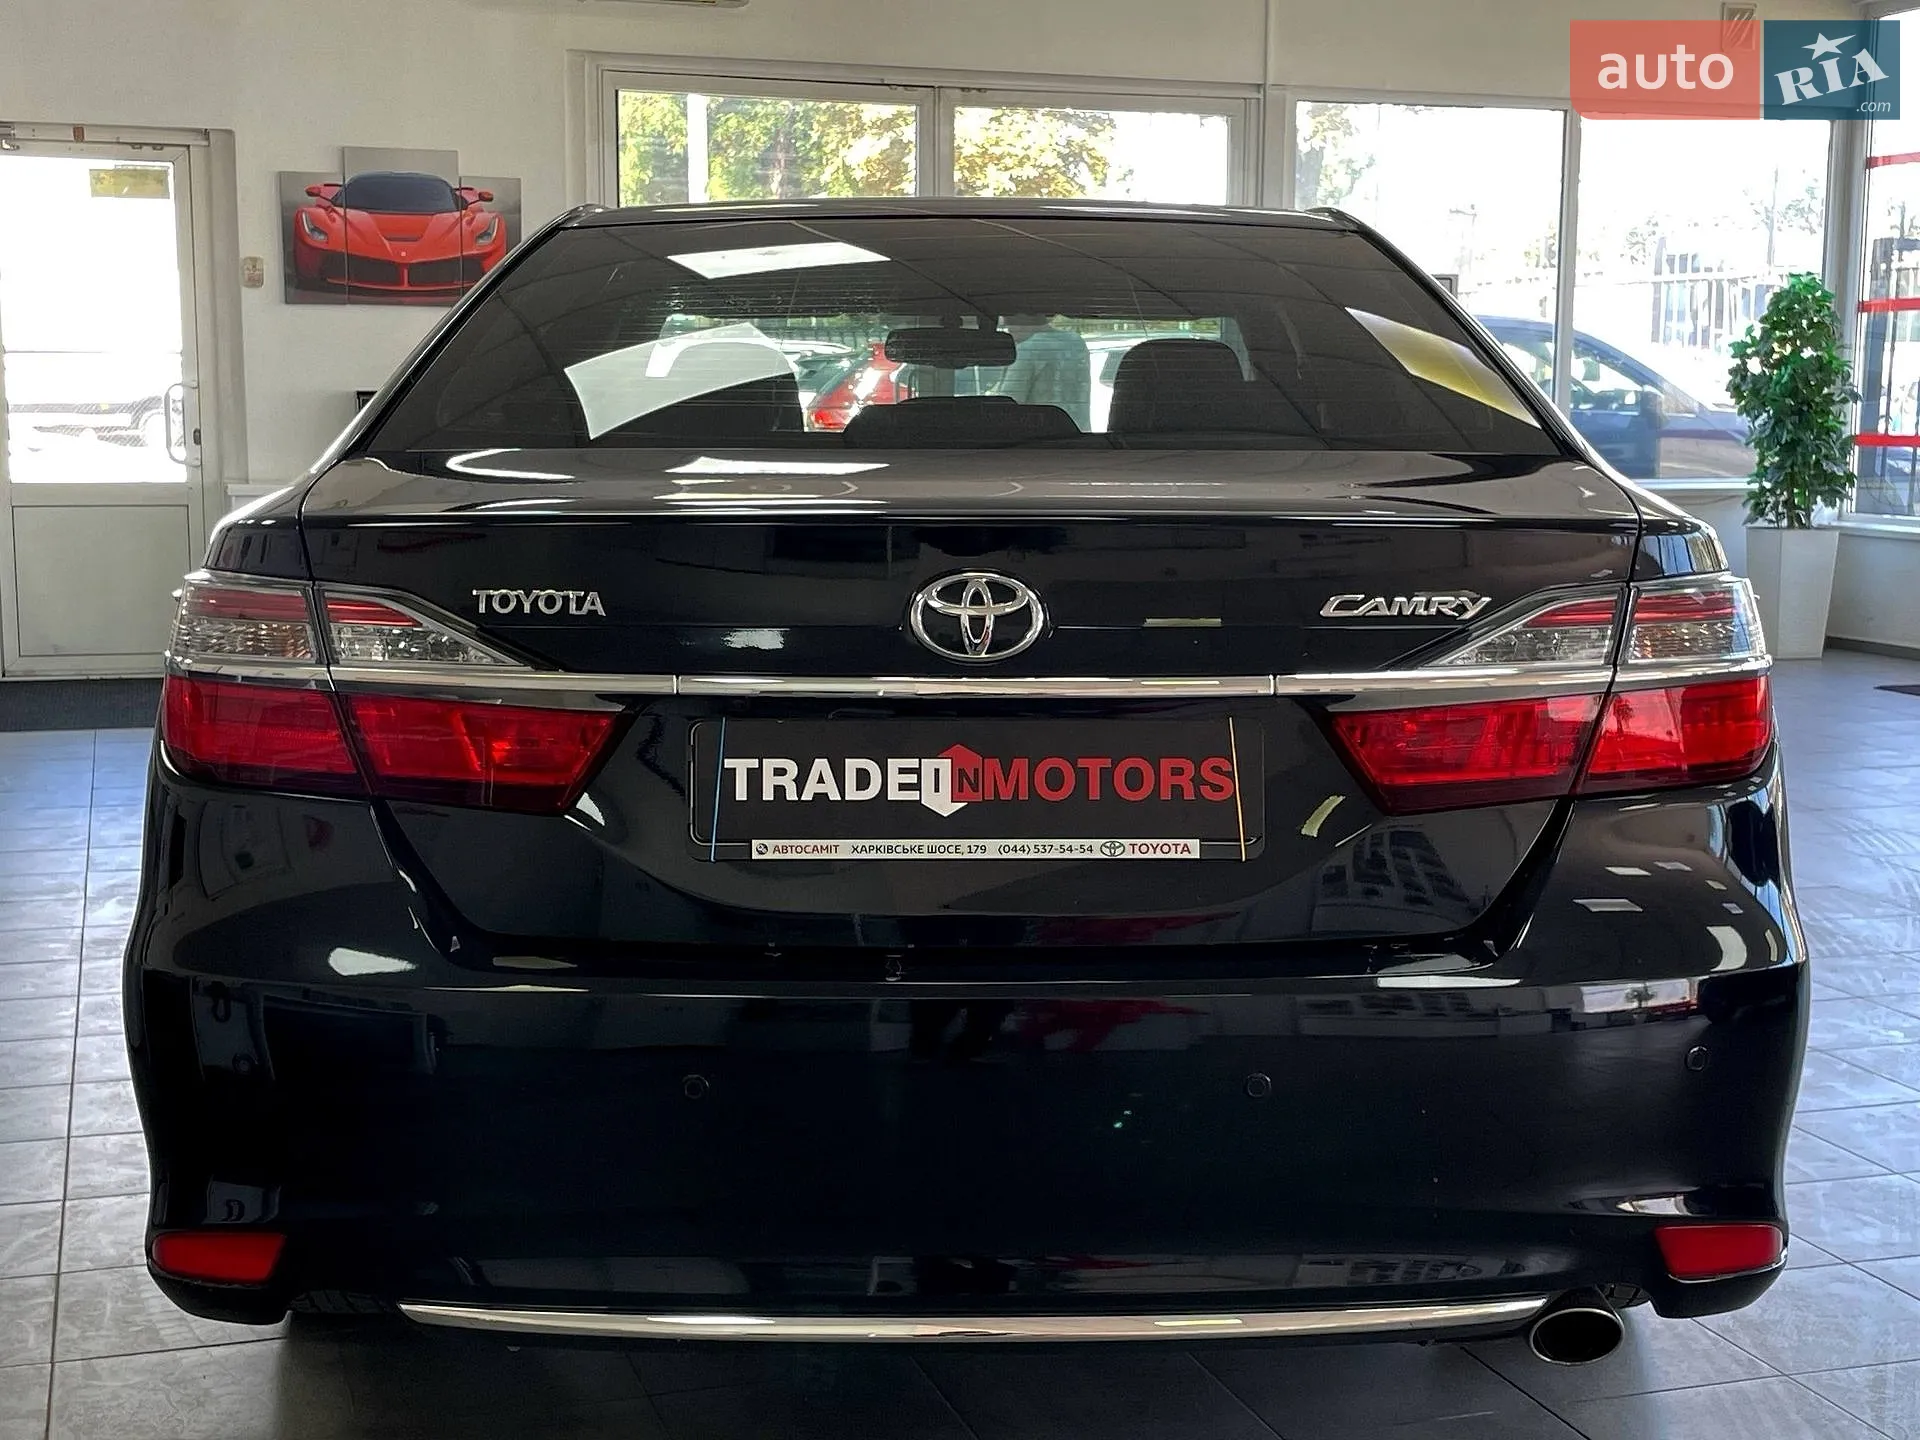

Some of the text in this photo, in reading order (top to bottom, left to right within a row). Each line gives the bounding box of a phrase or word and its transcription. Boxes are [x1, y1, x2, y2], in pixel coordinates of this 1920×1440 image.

[472, 588, 607, 617] TOYOTA
[1319, 593, 1492, 620] CAMRY
[983, 756, 1235, 803] MOTORS
[772, 844, 840, 855] АВТОСАМІТ
[851, 844, 987, 856] ХАРКІВСЬКЕ ШОСЕ, 179
[997, 844, 1094, 856] (044) 537-54-54
[1128, 843, 1192, 855] TOYOTA
